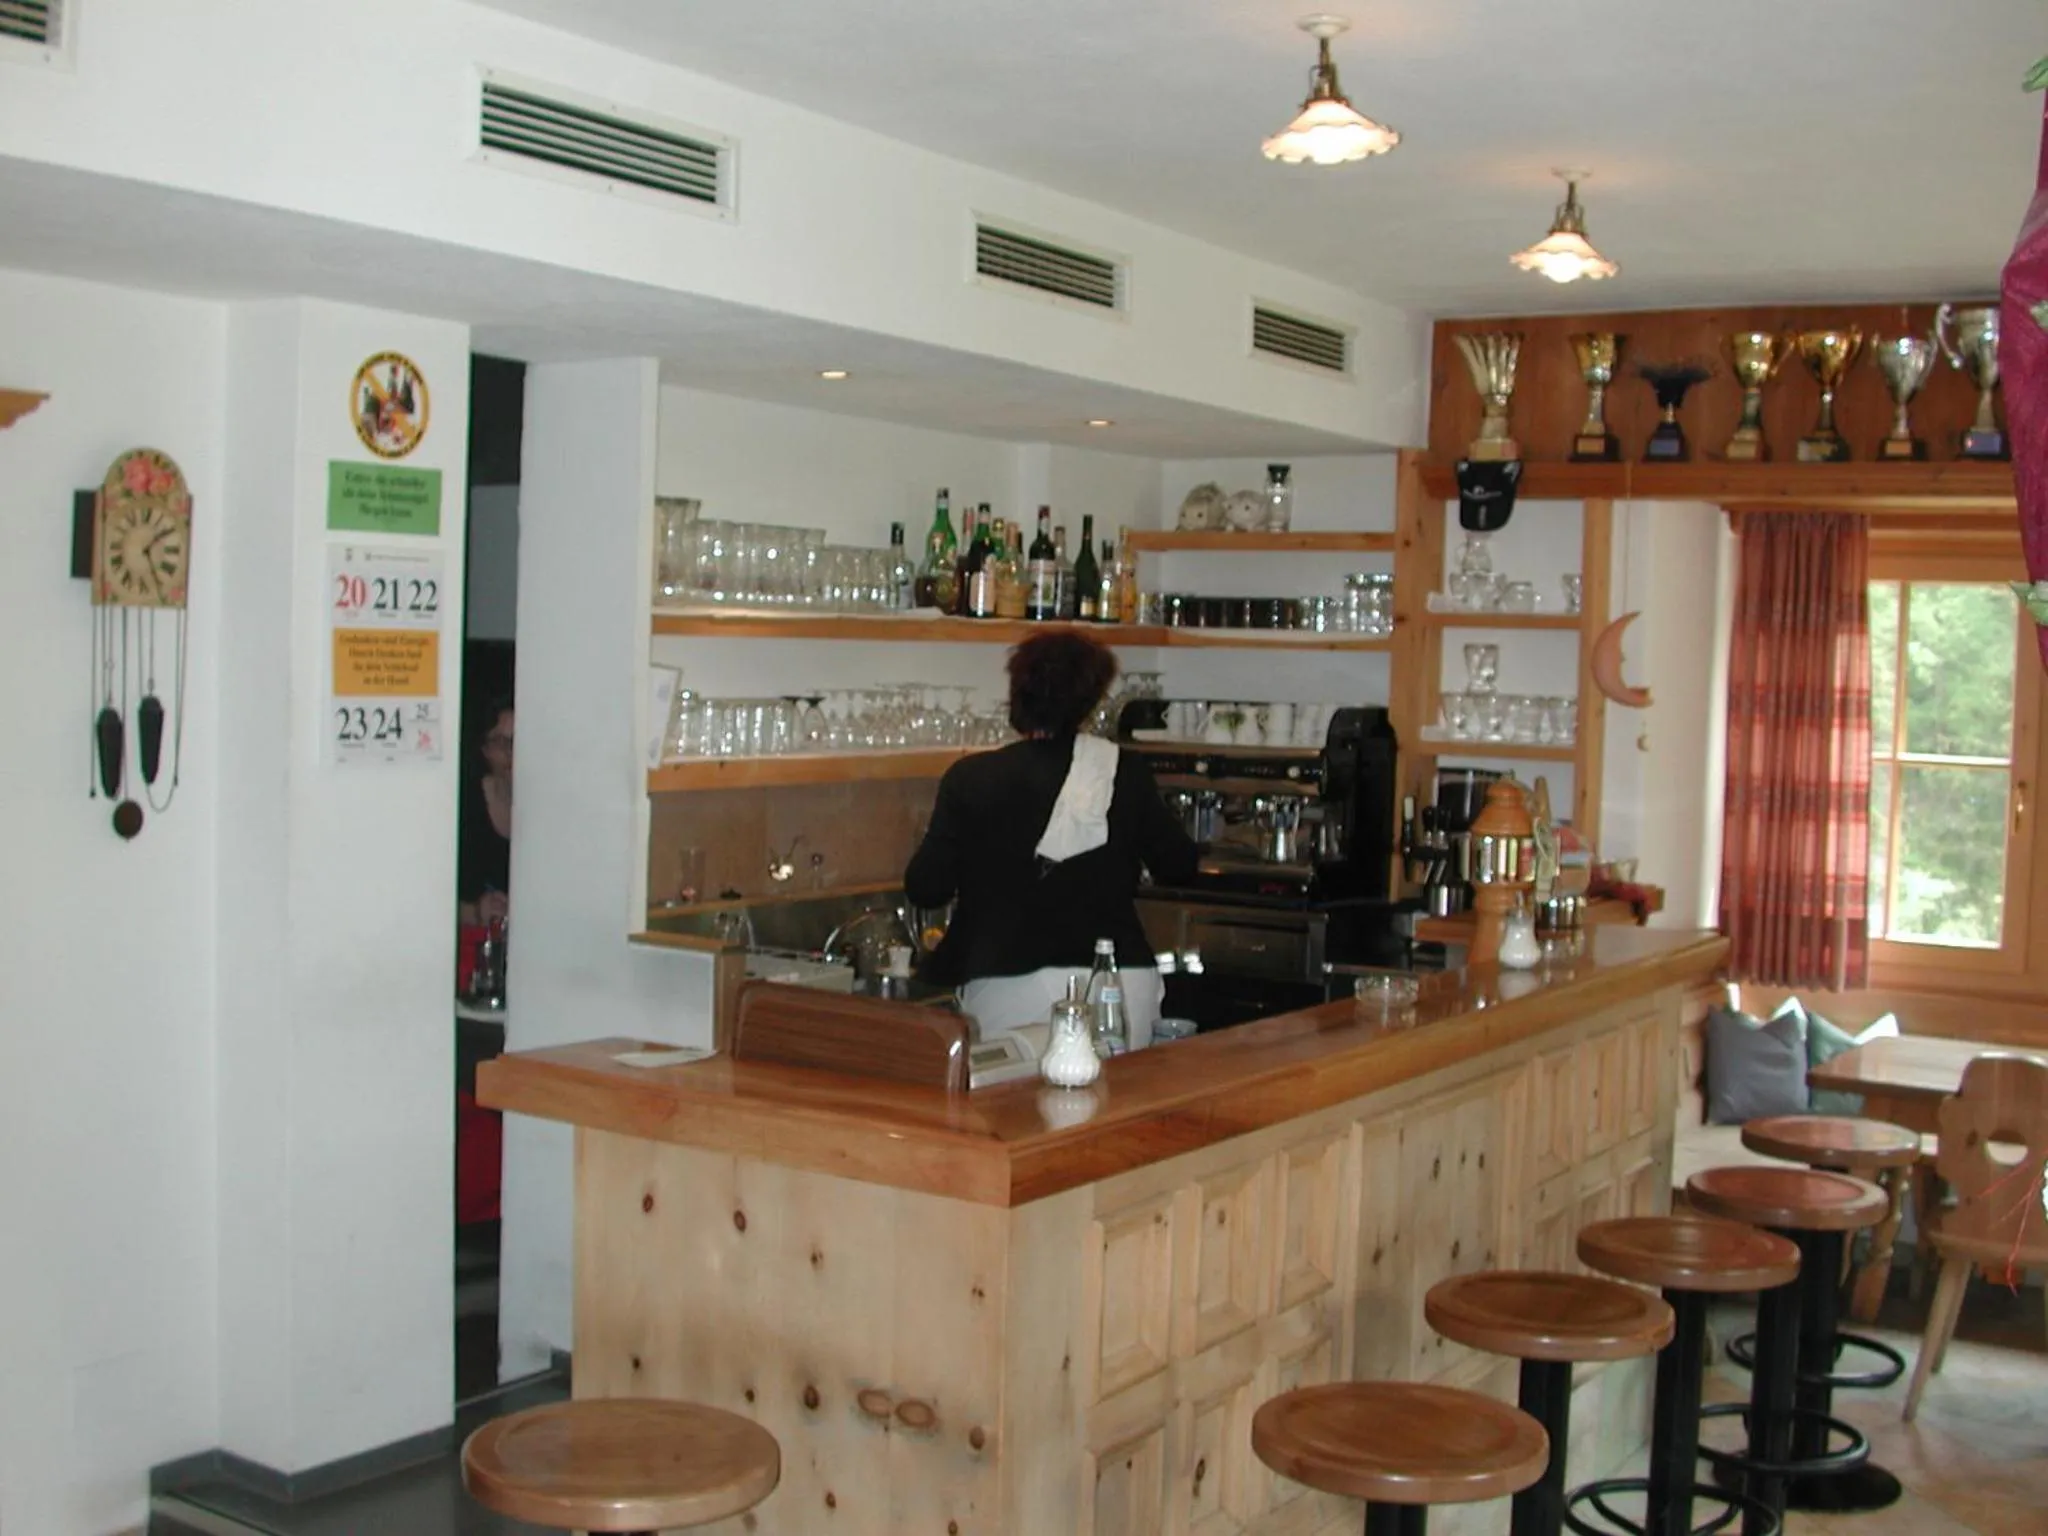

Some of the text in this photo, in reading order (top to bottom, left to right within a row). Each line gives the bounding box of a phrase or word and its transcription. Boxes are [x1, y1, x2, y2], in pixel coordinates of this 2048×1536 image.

[335, 575, 438, 611] 20 21 22
[336, 707, 403, 740] 23 24
